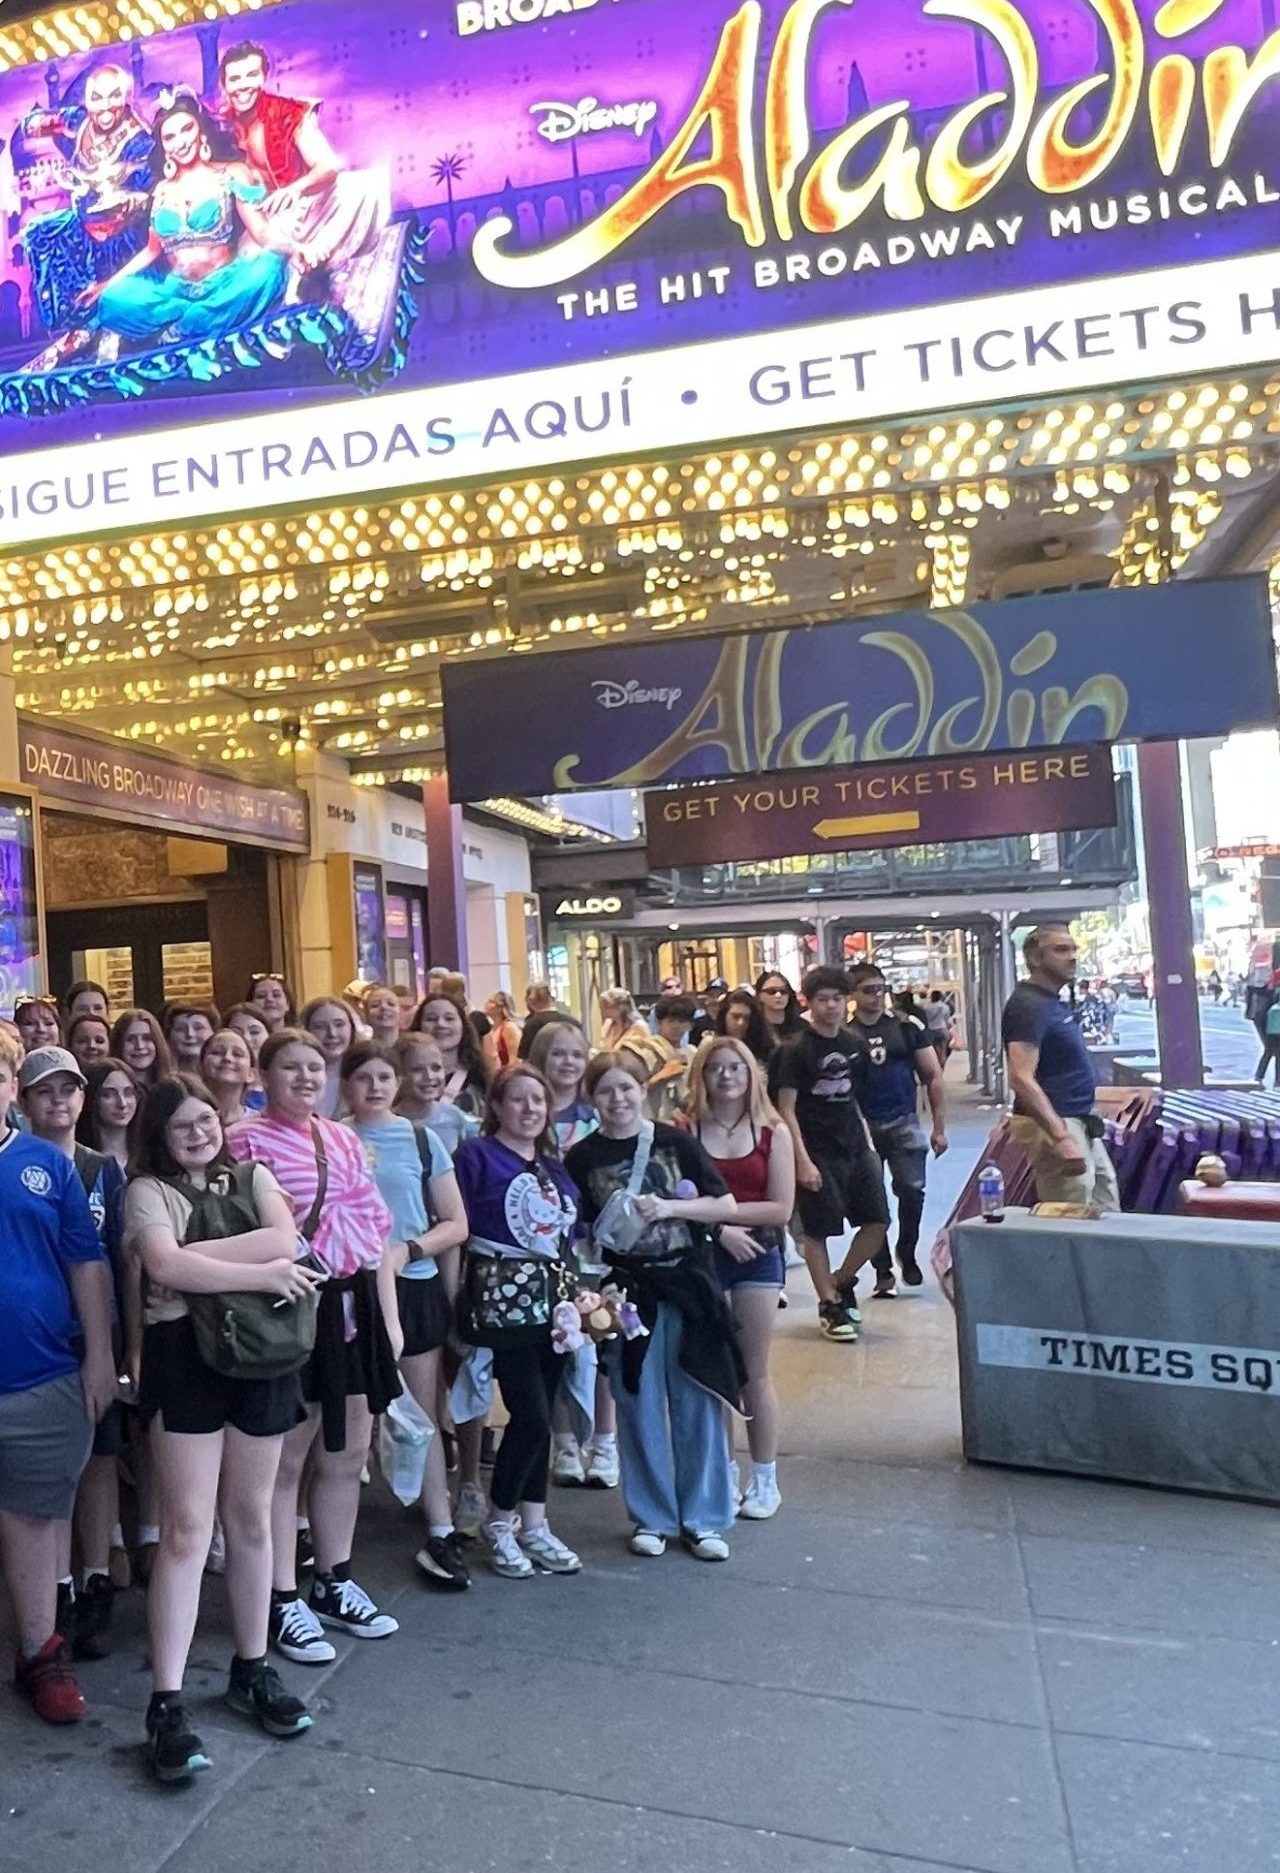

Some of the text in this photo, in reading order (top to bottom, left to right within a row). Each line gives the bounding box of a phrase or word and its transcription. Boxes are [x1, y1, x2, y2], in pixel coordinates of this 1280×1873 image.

[472, 0, 1280, 290] Aladdin
[528, 96, 657, 142] Disney
[556, 174, 1280, 322] THE HIT BROADWAY MUSICAL
[748, 348, 878, 407] GET
[904, 301, 1207, 381] TICKETS
[151, 416, 456, 497] ENTRADAS
[481, 375, 633, 447] AQUÍ
[553, 612, 1130, 789] Aladdin
[590, 678, 683, 709] Disney
[24, 743, 111, 788] DAZZLING
[113, 765, 194, 808] BROADWAY
[226, 793, 254, 819] WISH
[281, 805, 306, 831] TIME
[663, 754, 1091, 822] GET YOUR TICKETS HERE
[555, 896, 623, 917] ALDO
[1039, 1335, 1280, 1392] TIMES SQ
